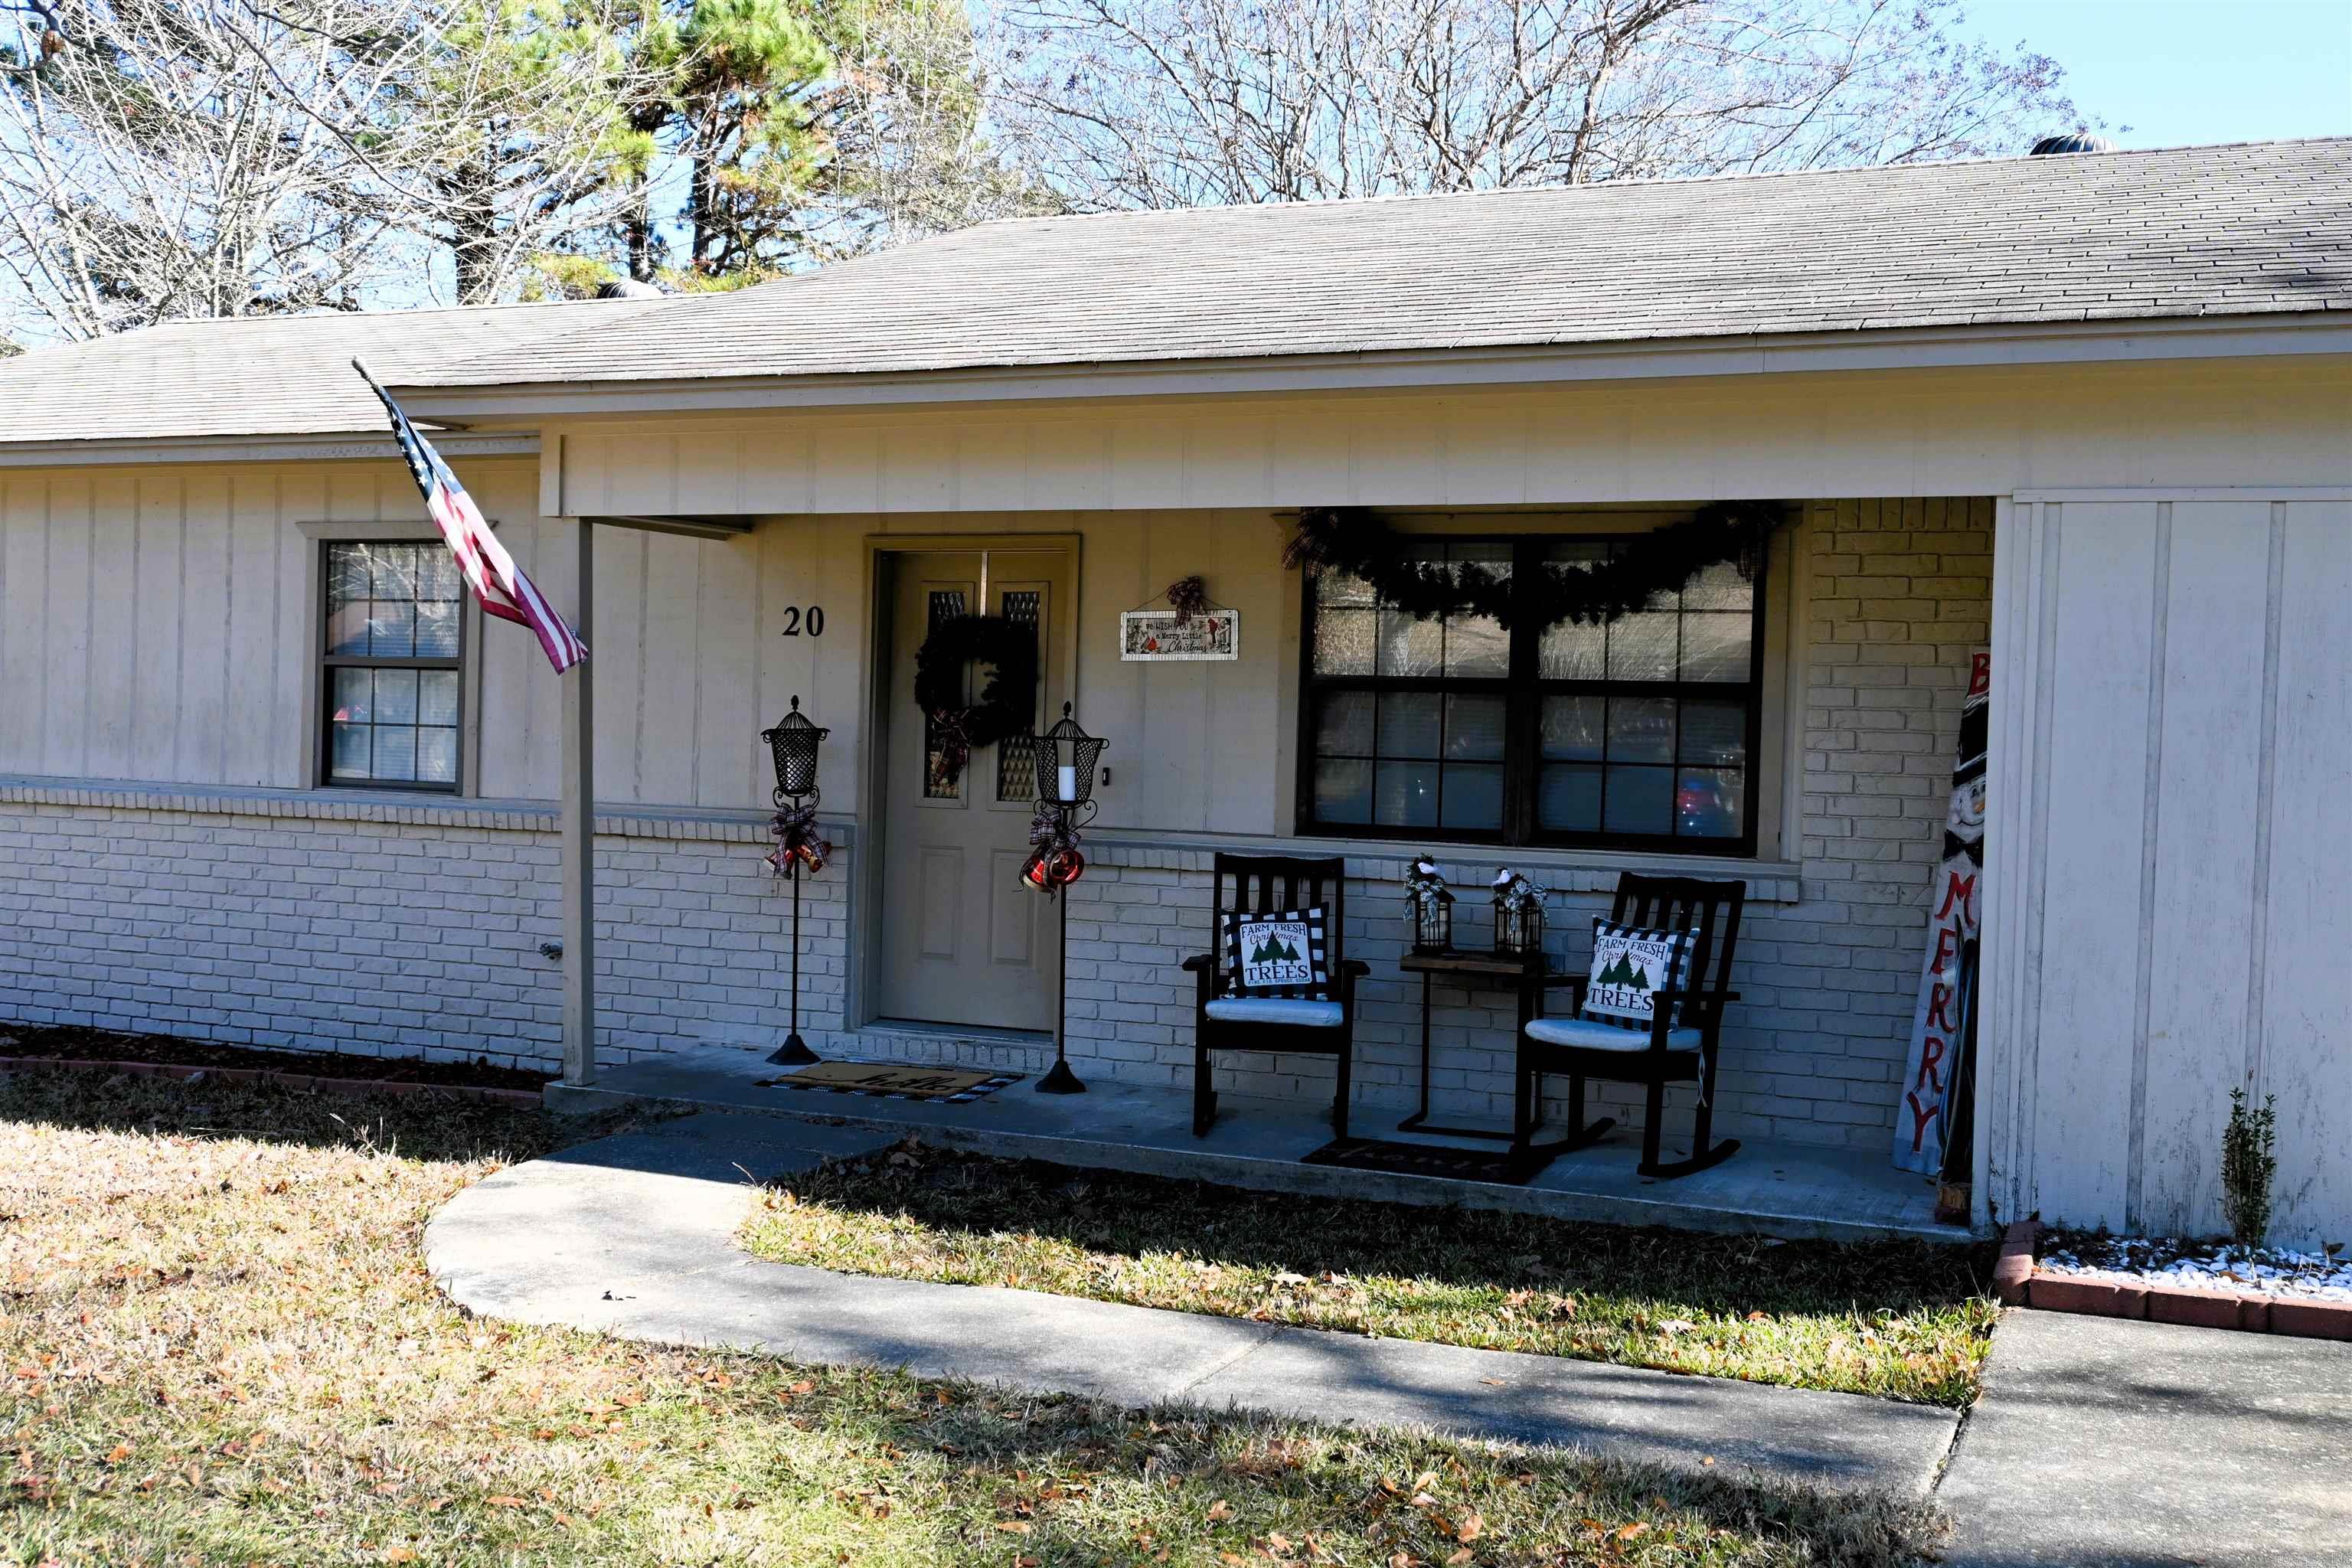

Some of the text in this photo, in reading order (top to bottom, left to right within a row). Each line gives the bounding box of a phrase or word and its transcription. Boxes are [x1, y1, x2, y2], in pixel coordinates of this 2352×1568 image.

[782, 606, 825, 637] 20
[1155, 622, 1173, 631] WISH
[1161, 632, 1180, 641] Merry
[1168, 640, 1207, 652] Christmas
[1241, 923, 1307, 939] FARM FRESH
[1250, 932, 1299, 945] Chritmas
[1597, 938, 1666, 960] FARM FRESH
[1245, 965, 1308, 981] TREES
[1590, 988, 1654, 1011] TREES
